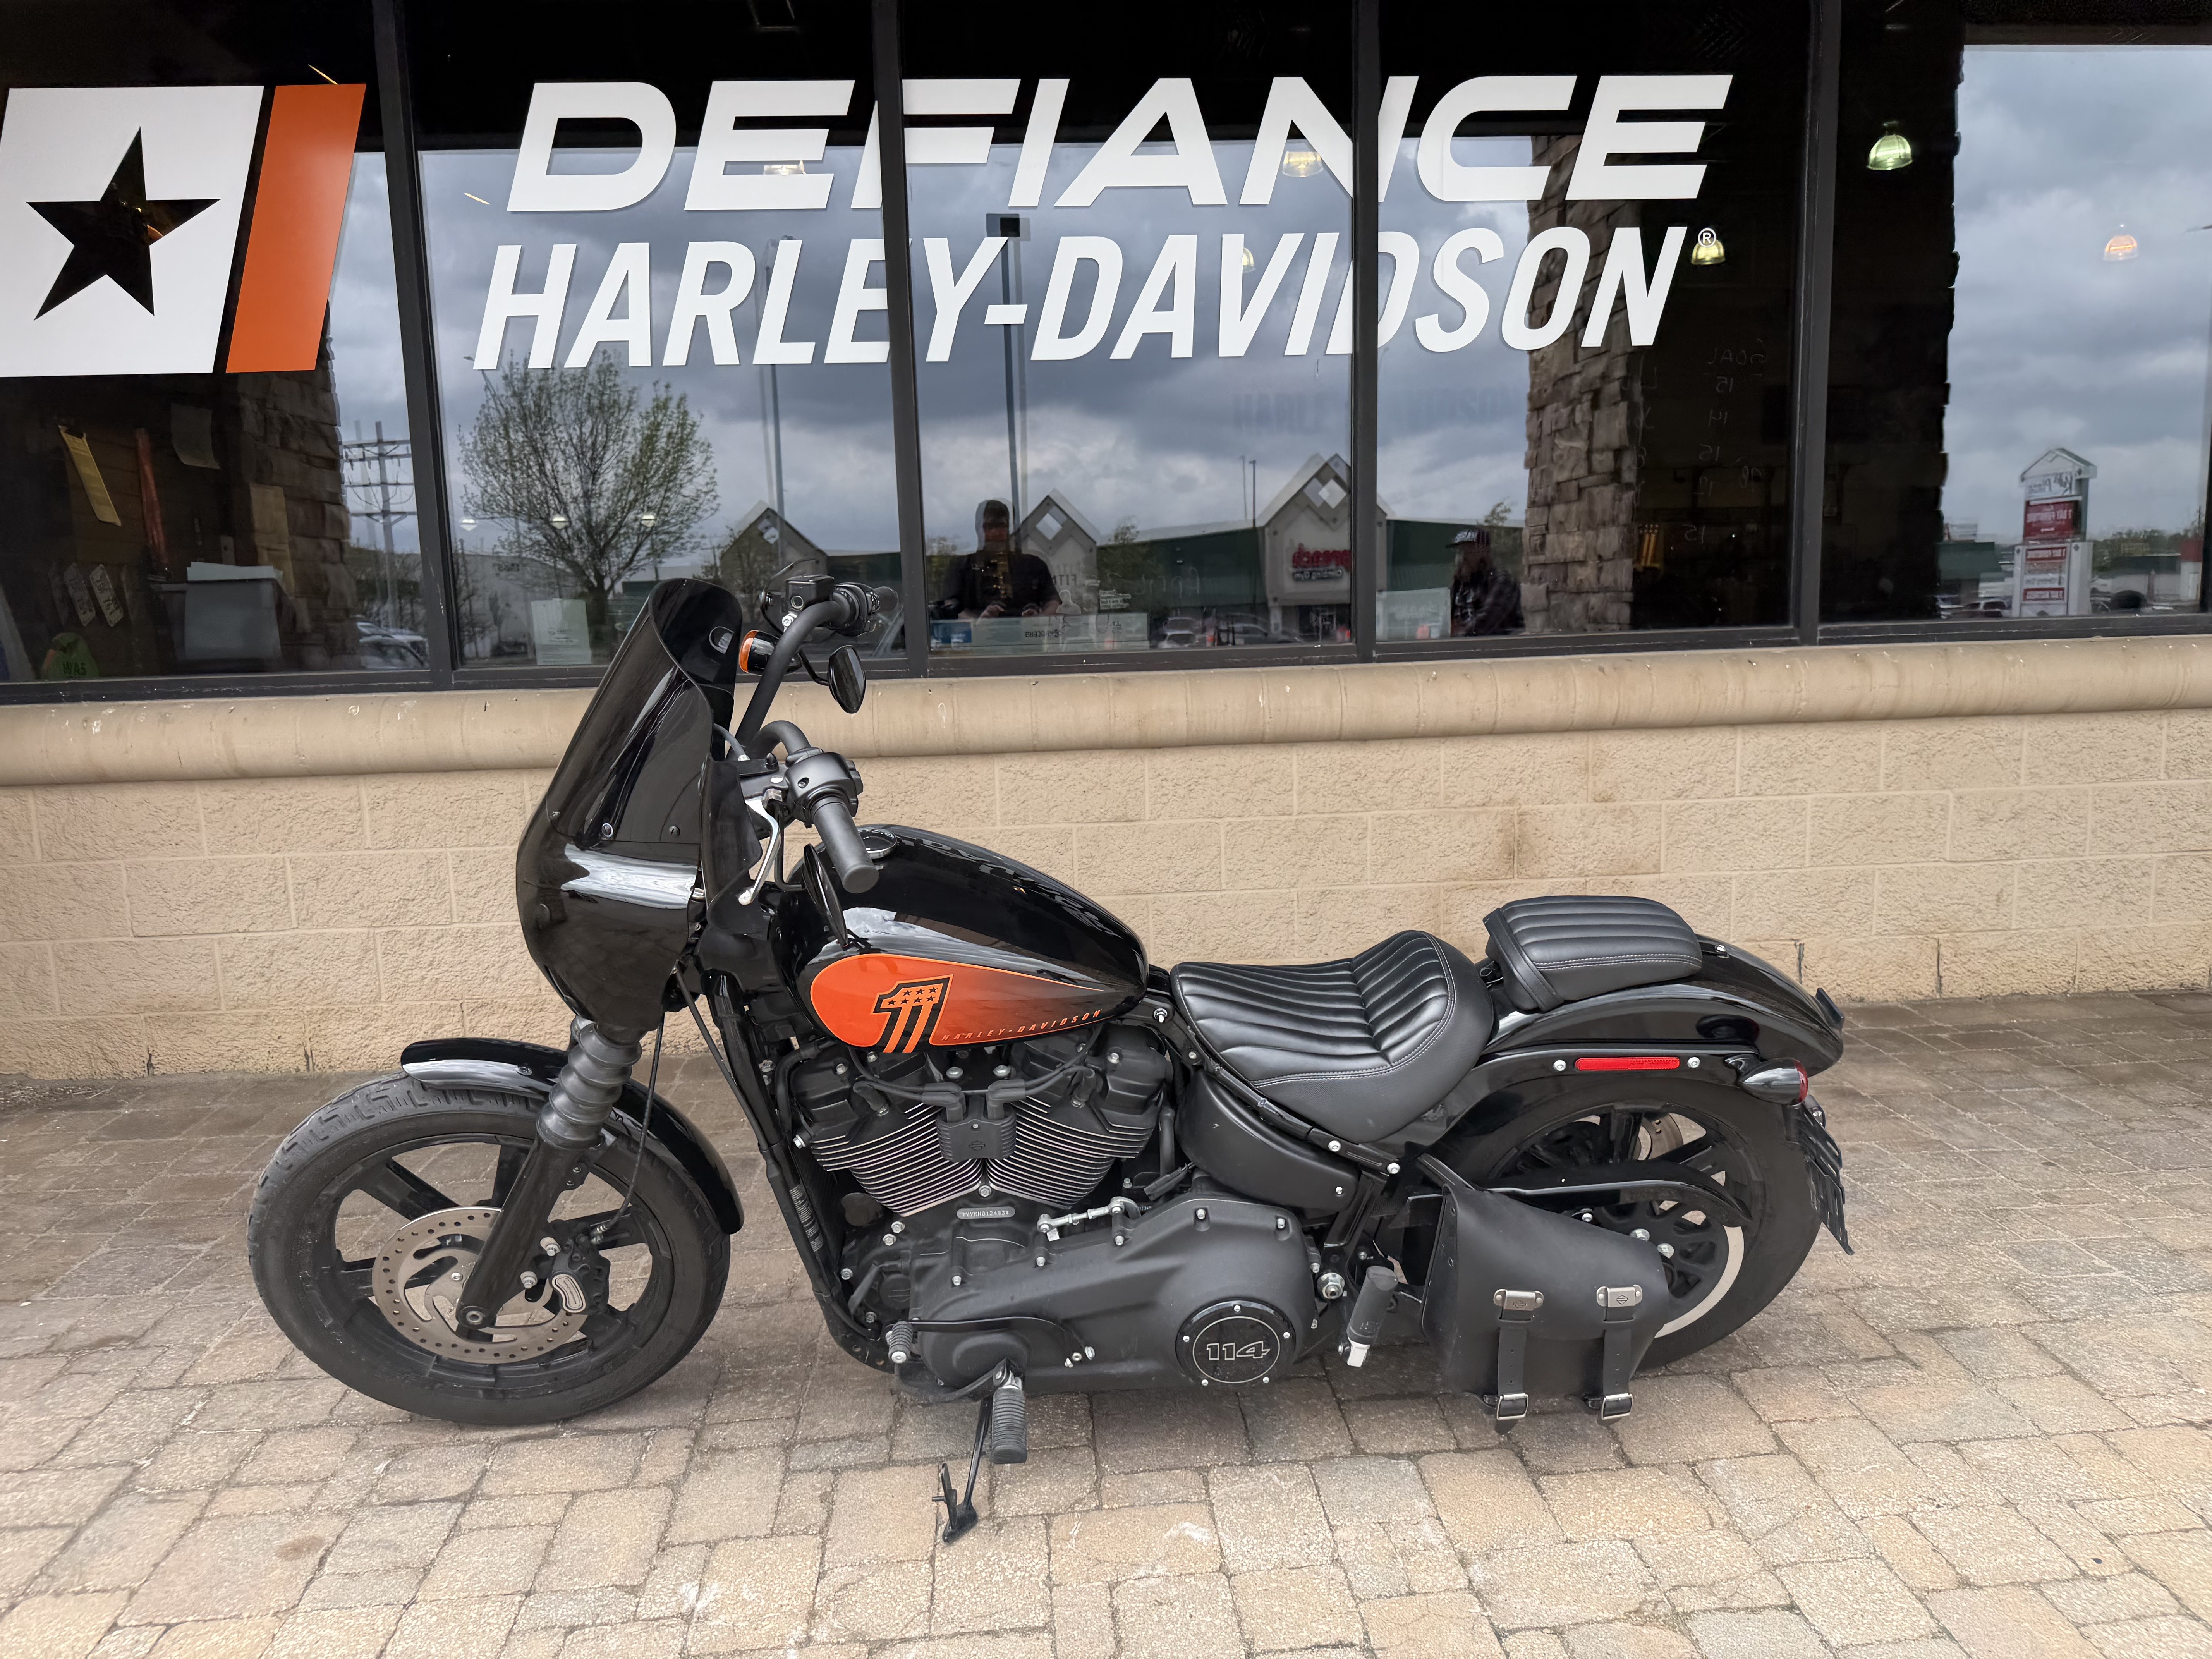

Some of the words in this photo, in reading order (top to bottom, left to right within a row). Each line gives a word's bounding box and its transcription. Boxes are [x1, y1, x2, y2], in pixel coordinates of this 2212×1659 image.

[507, 75, 1733, 211] DEFIANCE
[941, 1009, 1102, 1041] HARLEY-DAVIDSON
[1206, 1340, 1271, 1360] 114
